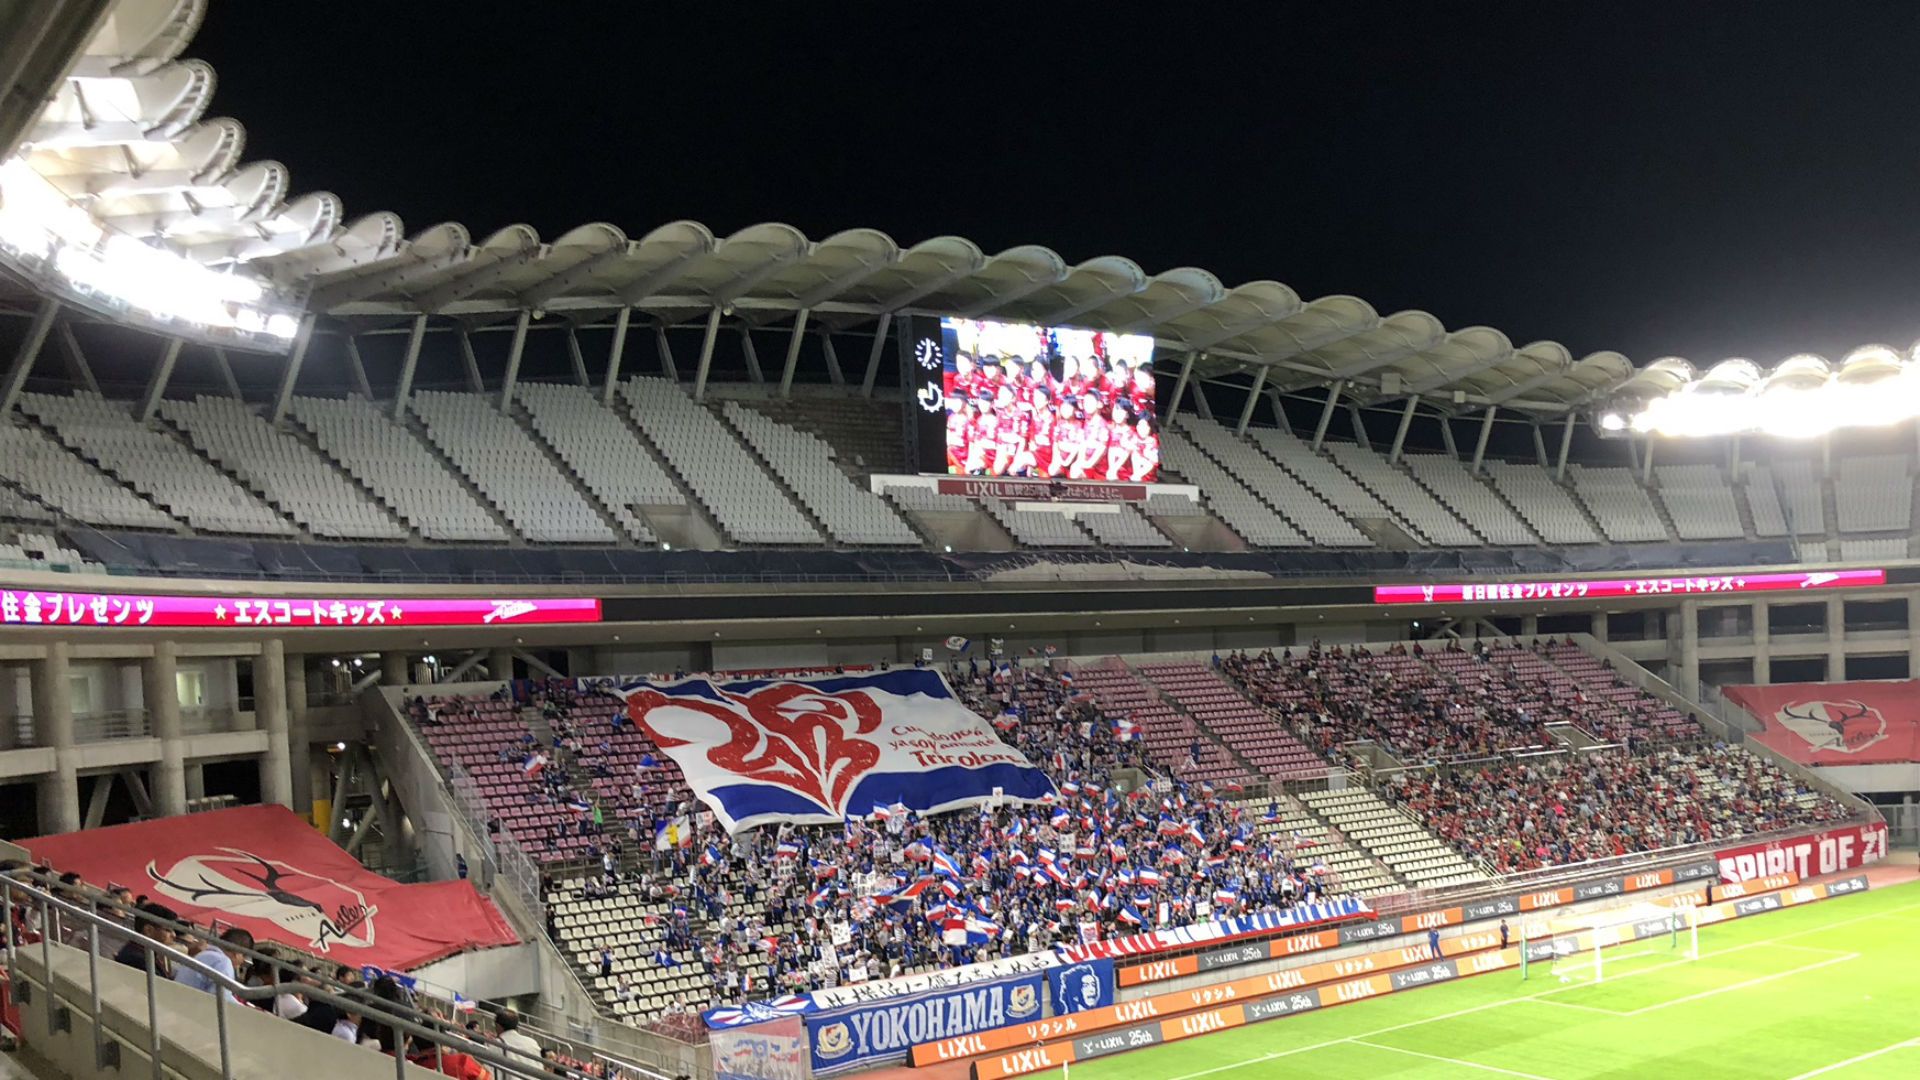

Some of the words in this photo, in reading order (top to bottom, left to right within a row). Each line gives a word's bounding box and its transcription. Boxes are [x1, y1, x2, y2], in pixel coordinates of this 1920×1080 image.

[965, 481, 1002, 496] LIXIL
[1636, 576, 1734, 594] エスコートキッズ
[234, 600, 386, 624] エスコートキッズ
[1719, 843, 1812, 884] SPIRIT
[1819, 835, 1855, 874] OF
[1636, 873, 1661, 887] LIXIL
[1533, 892, 1561, 907] LIXIL
[1416, 912, 1448, 928] LIXIL
[1286, 934, 1322, 953] LIXIL
[1242, 948, 1262, 961] 25th
[1139, 960, 1179, 981] LIXIL
[1267, 970, 1306, 991] LIXIL
[1191, 986, 1235, 1004] リクシル
[1337, 980, 1376, 1001] LIXIL
[850, 986, 1006, 1055] YOKOHAMA
[1115, 1001, 1158, 1023] LIXIL
[1027, 1018, 1077, 1038] リクシル
[1181, 1012, 1226, 1034] LIXIL
[937, 1035, 986, 1058] LIXIL
[1100, 1037, 1125, 1049] LIXIL
[1128, 1030, 1153, 1046] 25th
[1001, 1050, 1051, 1074] LIXIL
